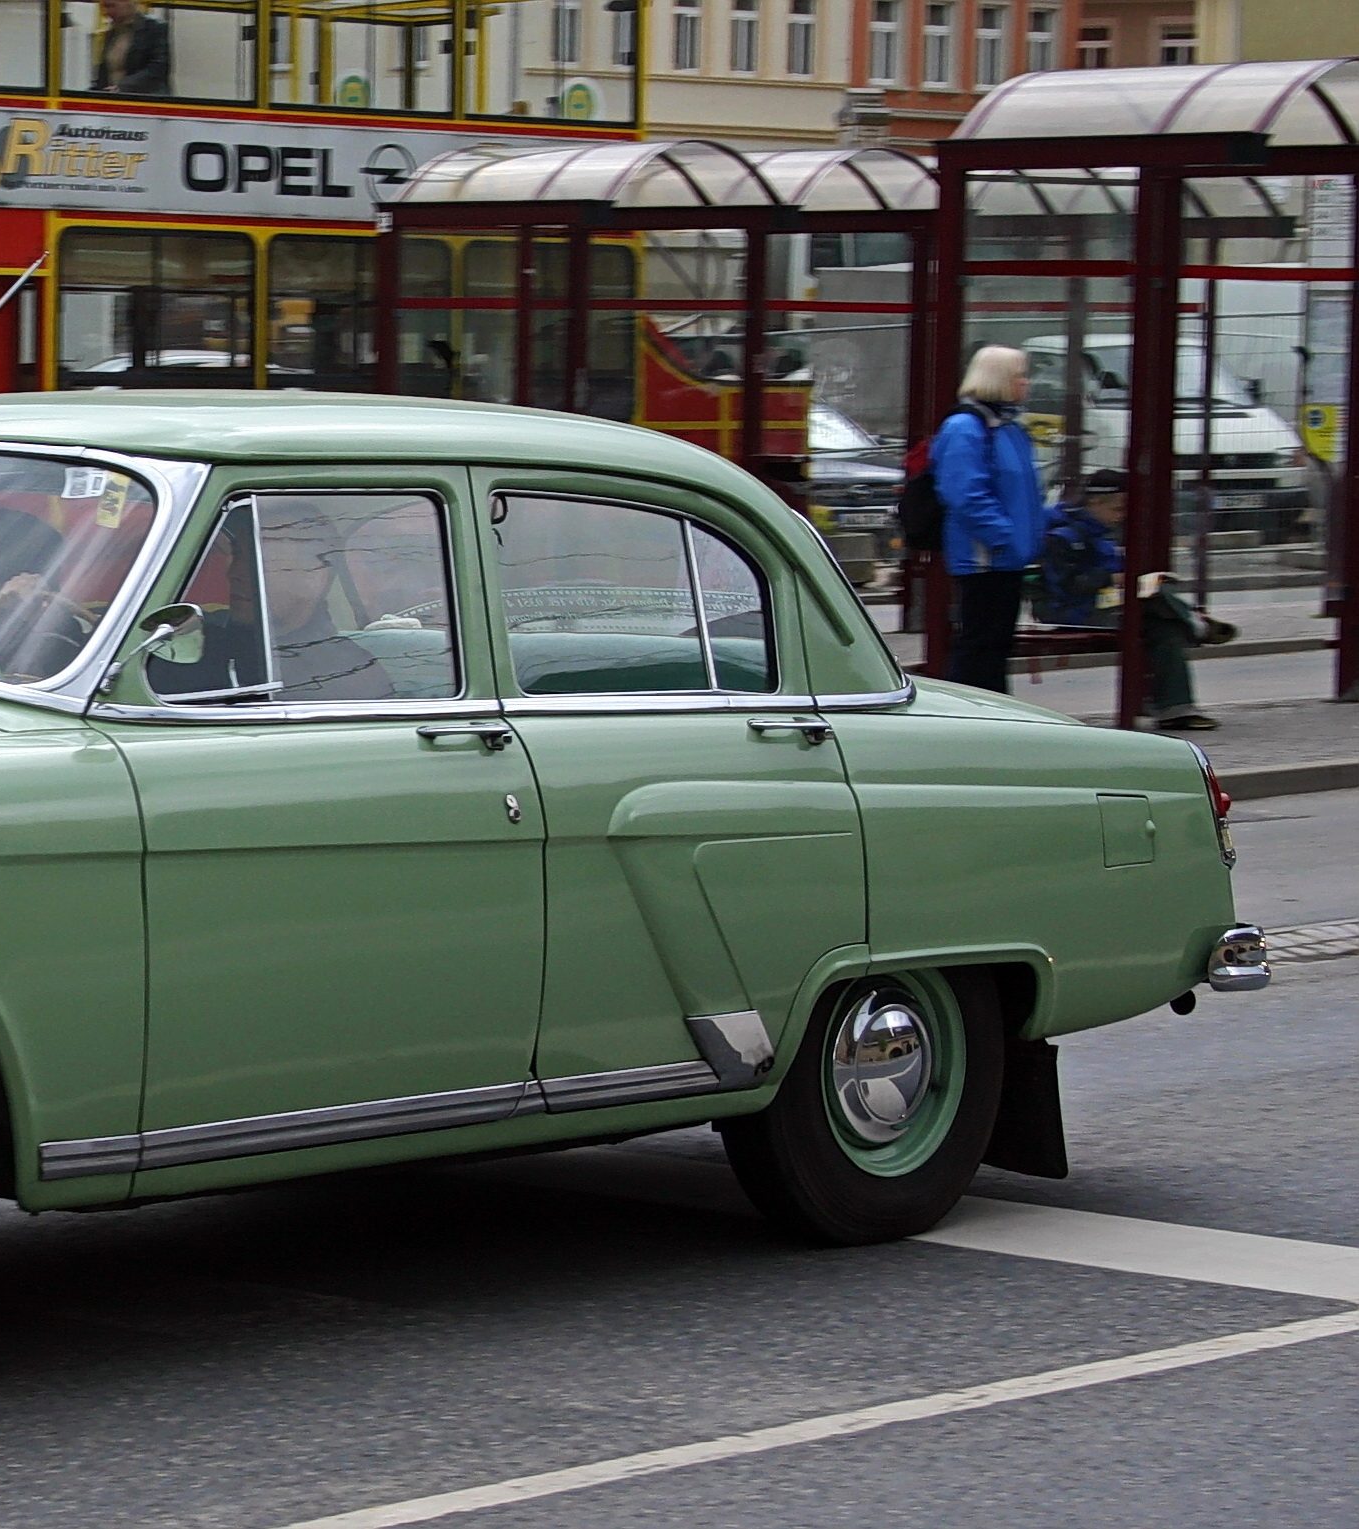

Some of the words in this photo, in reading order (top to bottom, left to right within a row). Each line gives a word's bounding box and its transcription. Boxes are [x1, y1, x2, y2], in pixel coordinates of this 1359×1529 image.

[0, 117, 149, 180] Ritter
[53, 123, 149, 142] Autohaus
[181, 141, 355, 197] OPEL
